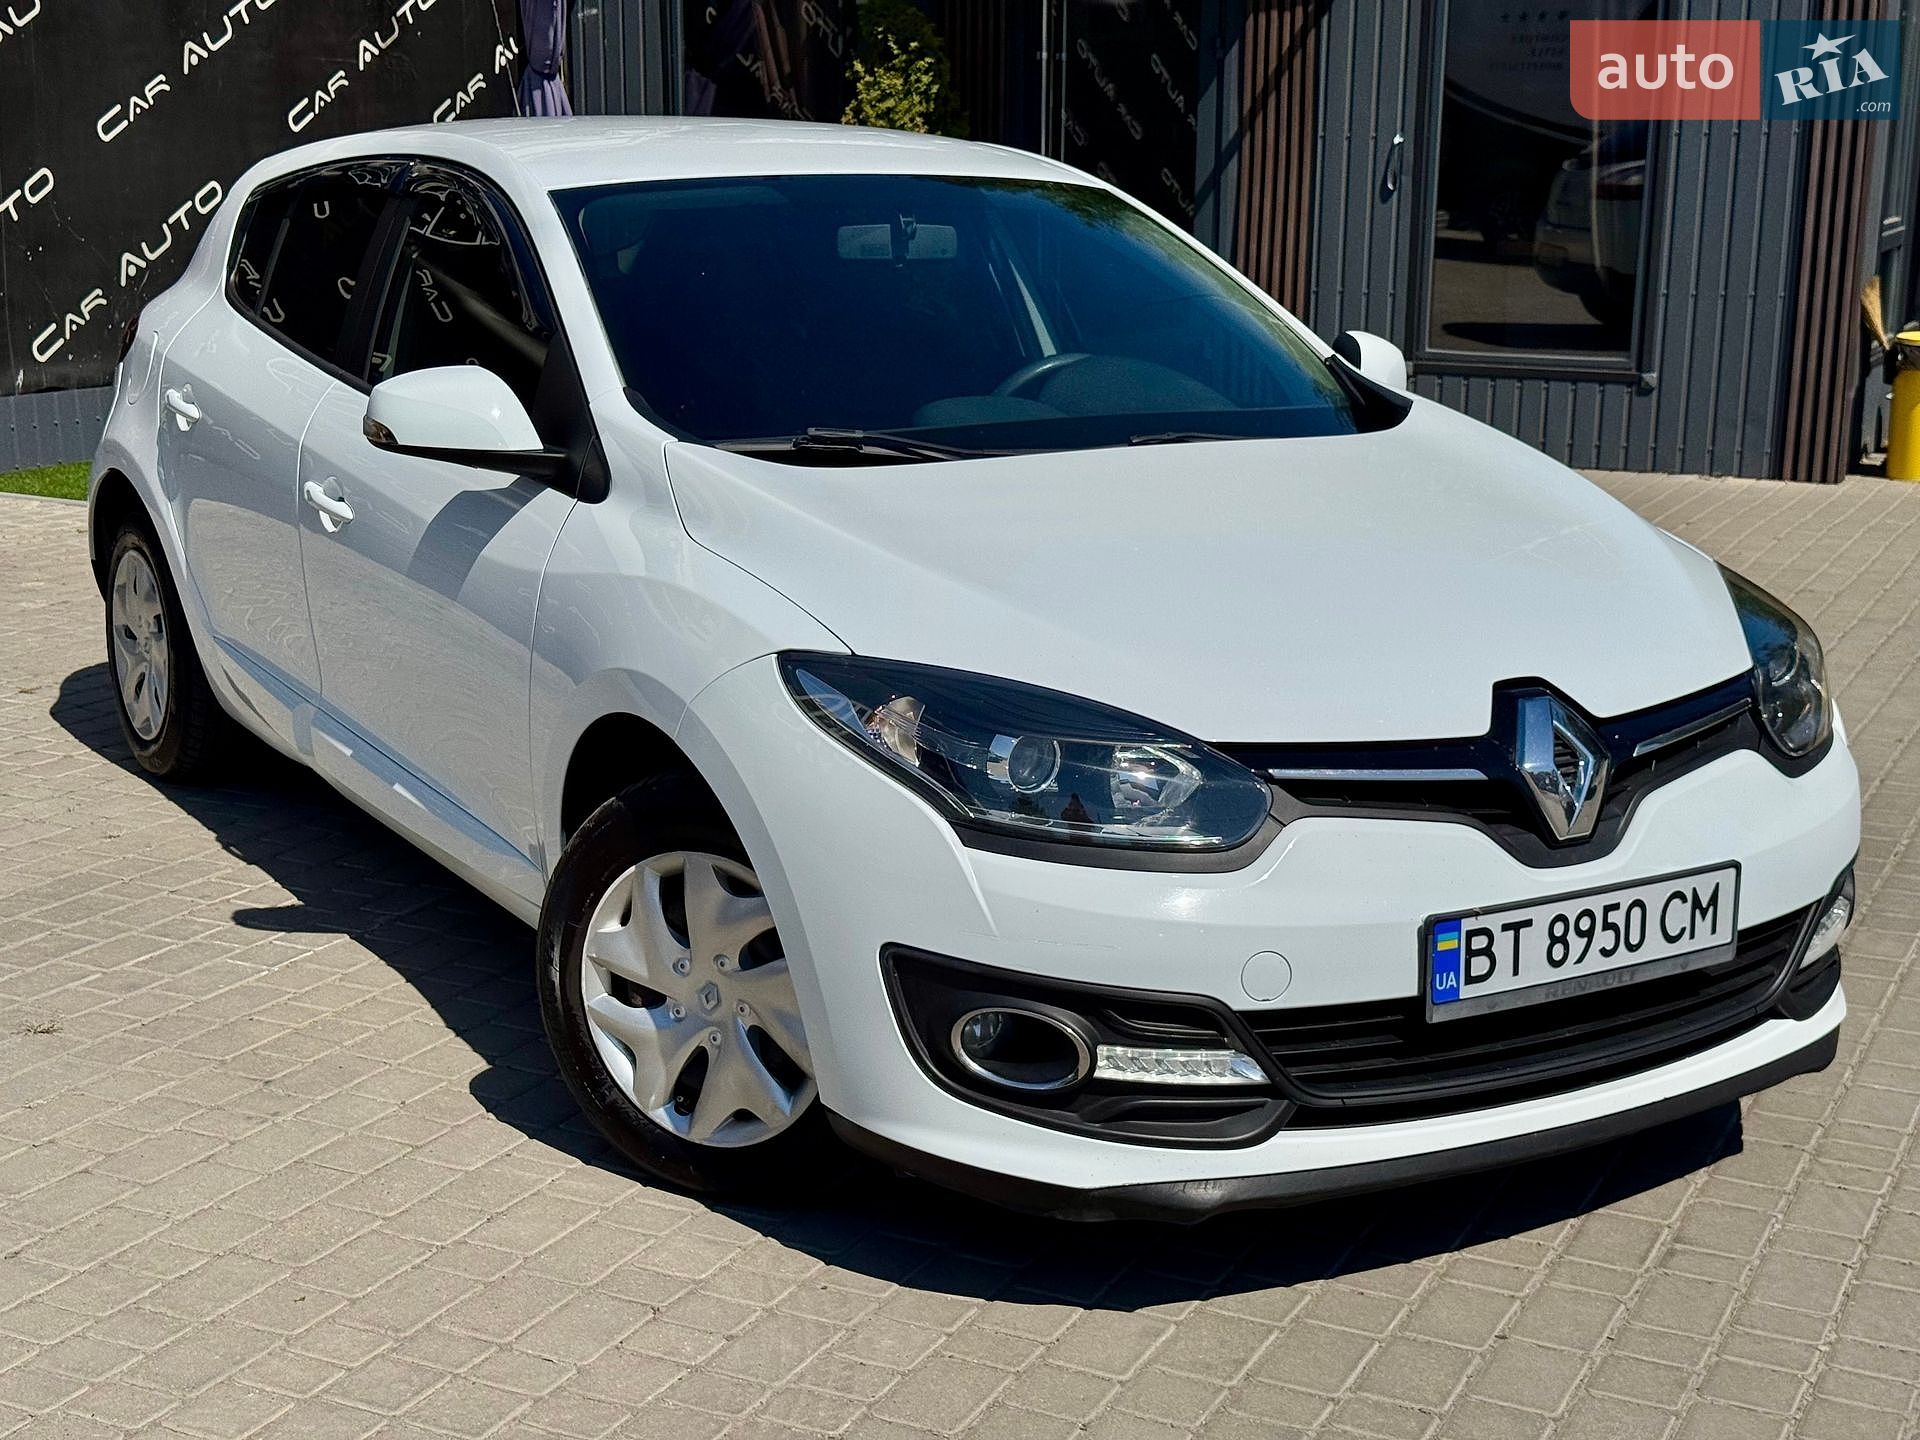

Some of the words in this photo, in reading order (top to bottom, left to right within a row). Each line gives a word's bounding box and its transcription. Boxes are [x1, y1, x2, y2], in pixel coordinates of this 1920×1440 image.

[97, 74, 171, 143] CAR
[183, 0, 276, 75] AUT
[287, 70, 350, 133] CAR
[358, 0, 437, 71] AUT
[32, 288, 107, 363] CAR
[119, 180, 223, 287] AUTO
[1436, 971, 1457, 992] UA
[1464, 918, 1534, 986] BT
[1545, 898, 1647, 970] 8950
[1659, 882, 1721, 945] CM
